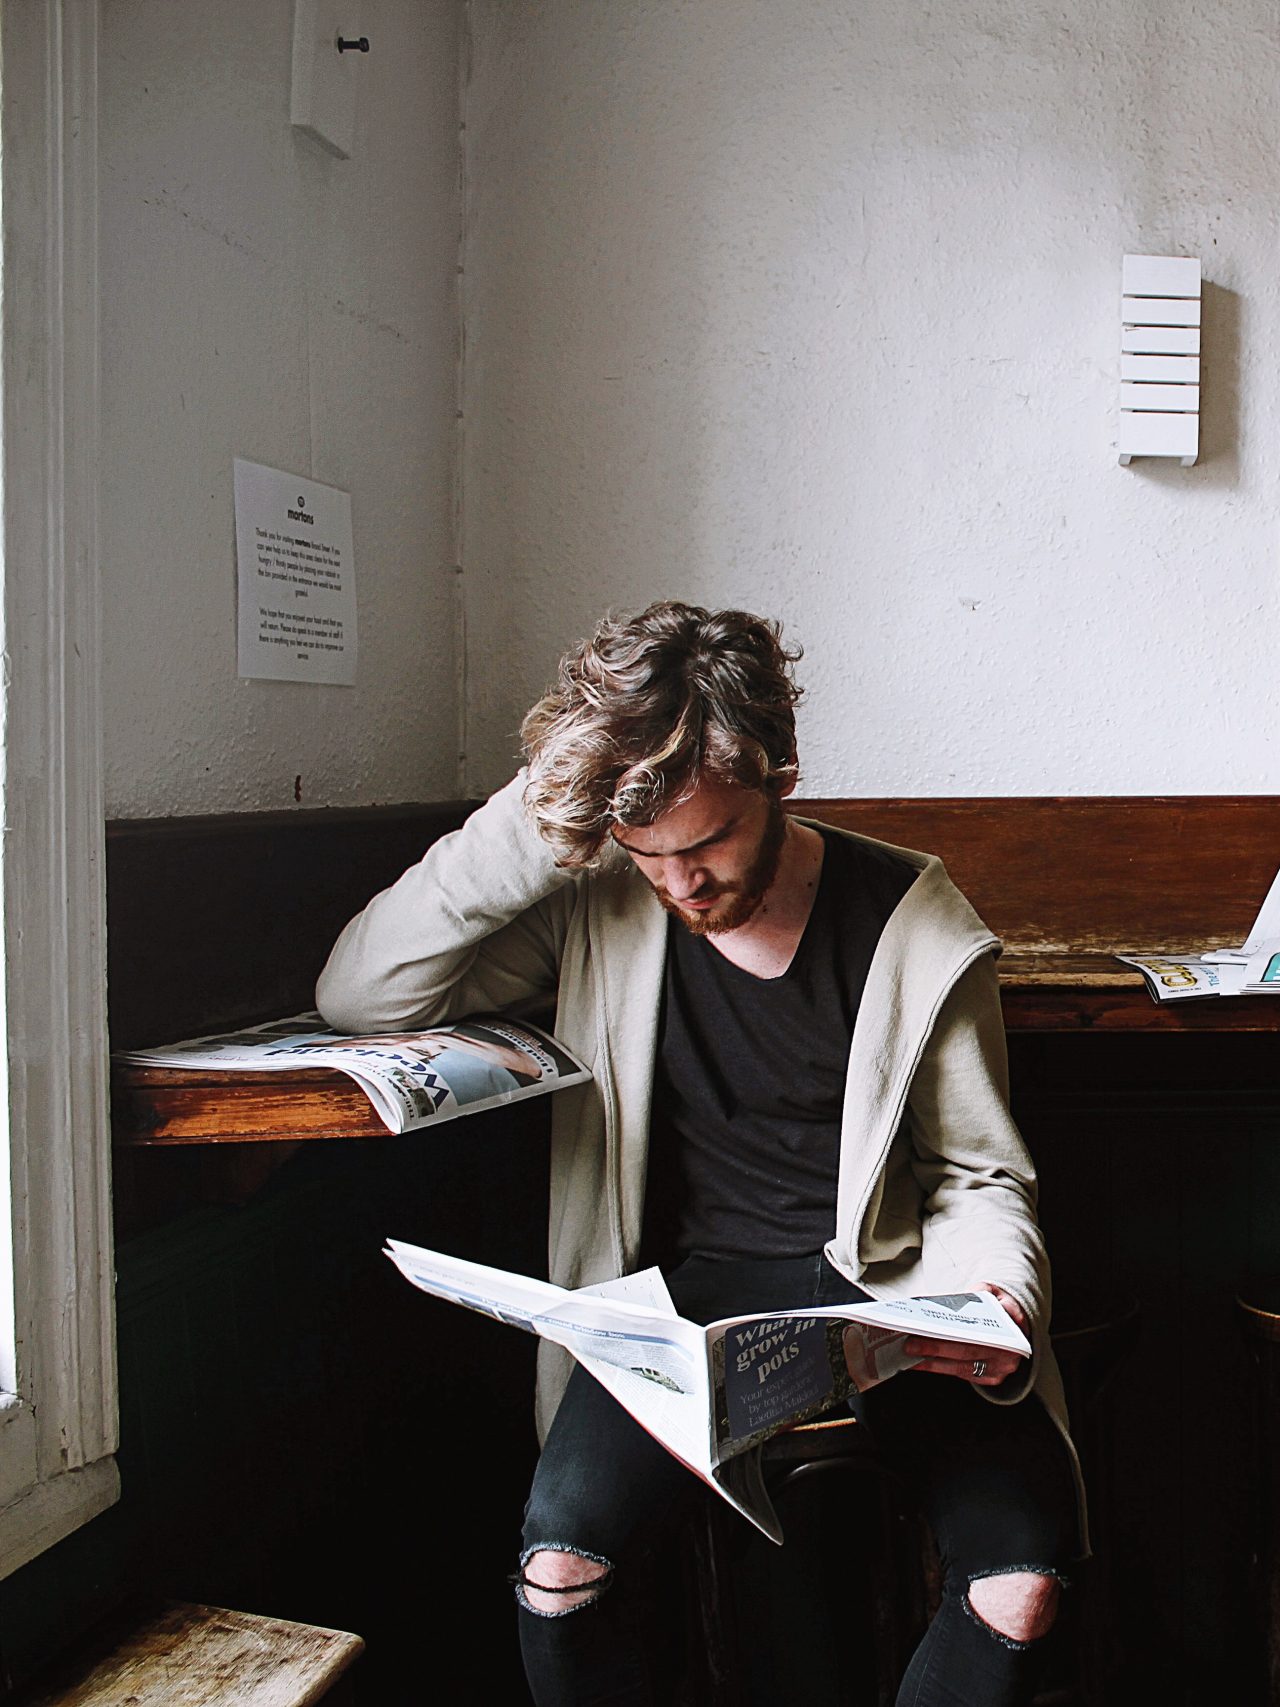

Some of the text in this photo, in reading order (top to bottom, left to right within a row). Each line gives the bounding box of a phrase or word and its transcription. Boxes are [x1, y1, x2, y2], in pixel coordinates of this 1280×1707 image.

[287, 509, 314, 525] mortons
[263, 1048, 450, 1112] Weekend
[735, 1318, 794, 1347] What
[736, 1318, 817, 1372] grow in
[757, 1341, 800, 1385] pots
[740, 1388, 764, 1405] Your
